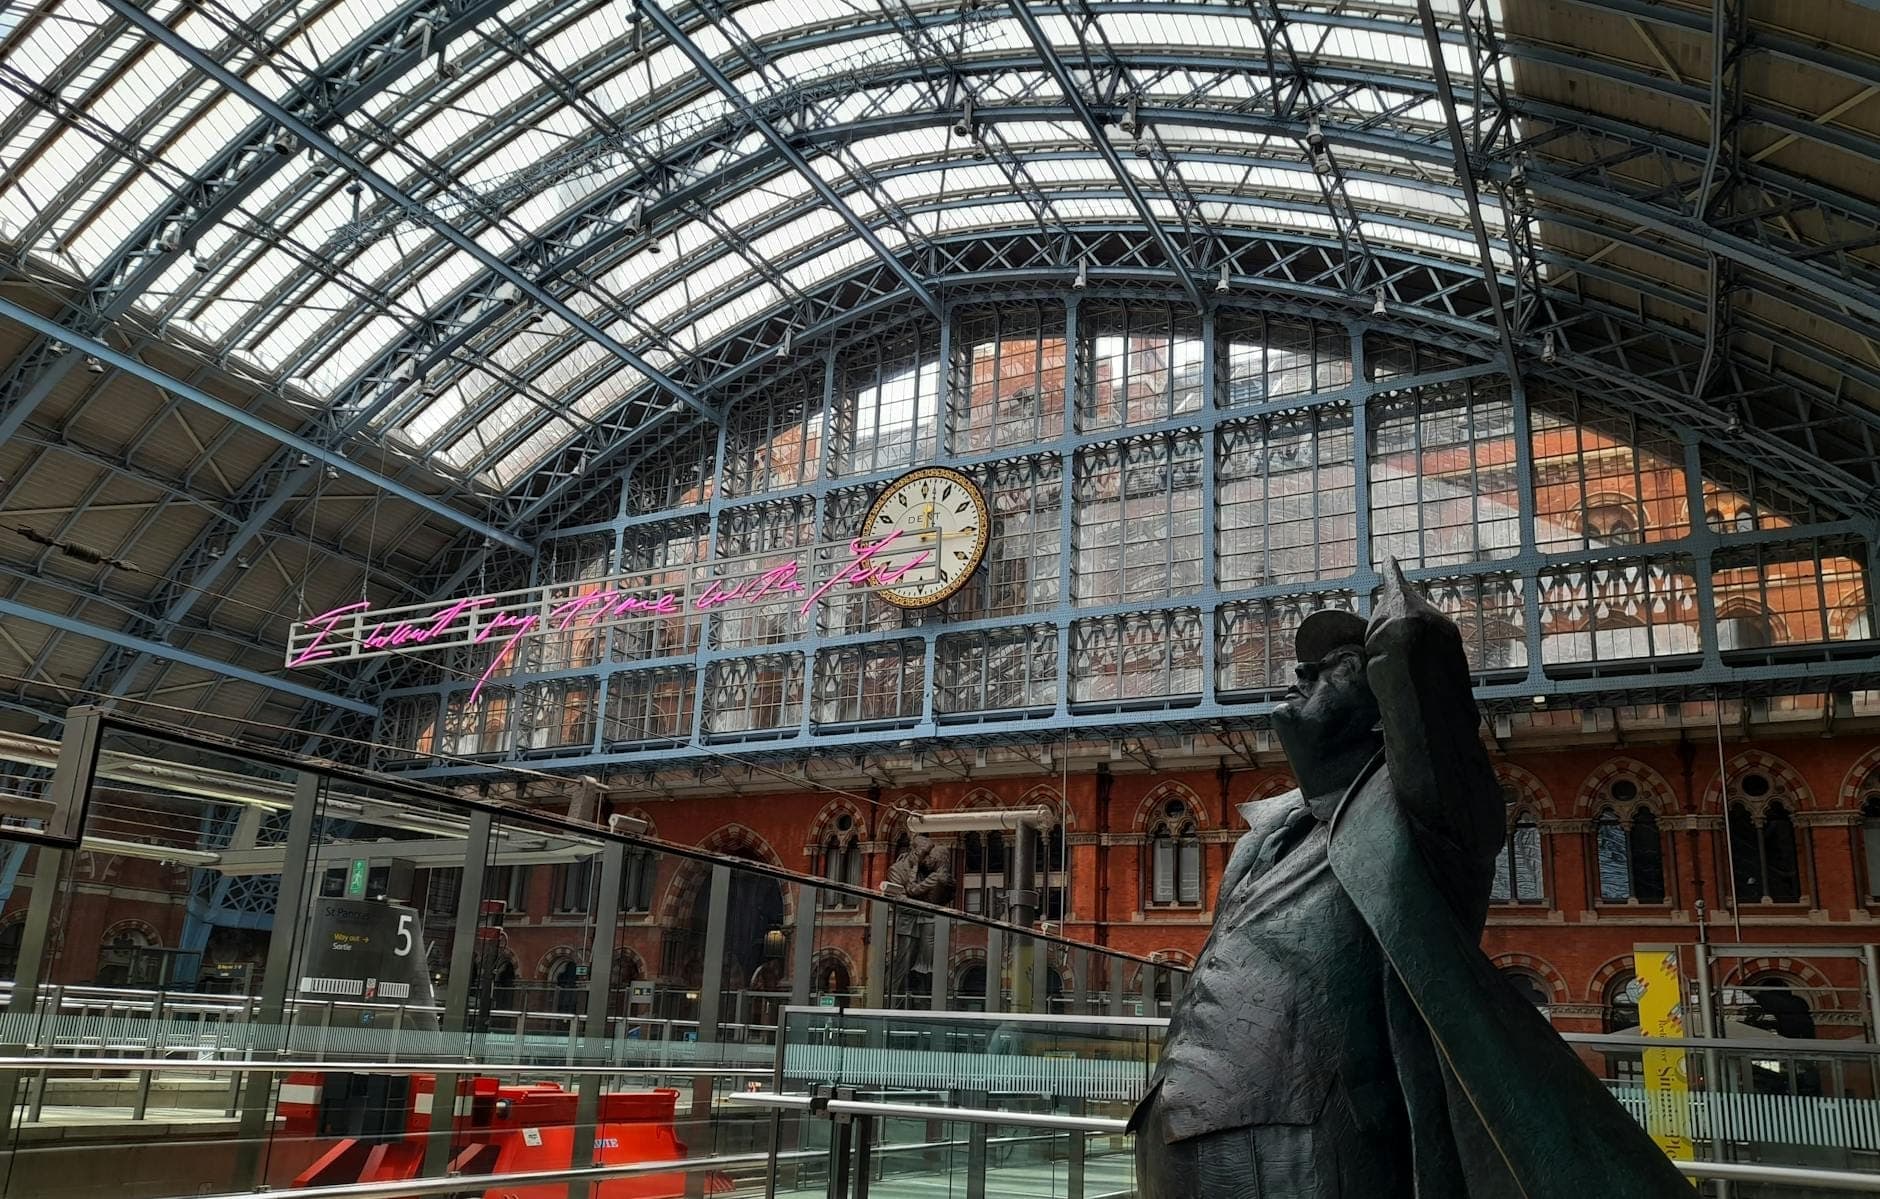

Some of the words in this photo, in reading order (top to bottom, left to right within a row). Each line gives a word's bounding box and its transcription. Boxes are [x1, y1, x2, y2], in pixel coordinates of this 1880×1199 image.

[287, 601, 370, 668] I
[326, 907, 335, 916] St
[334, 932, 349, 943] Way
[349, 934, 360, 942] out
[394, 915, 413, 957] 5
[332, 942, 352, 951] Sortie
